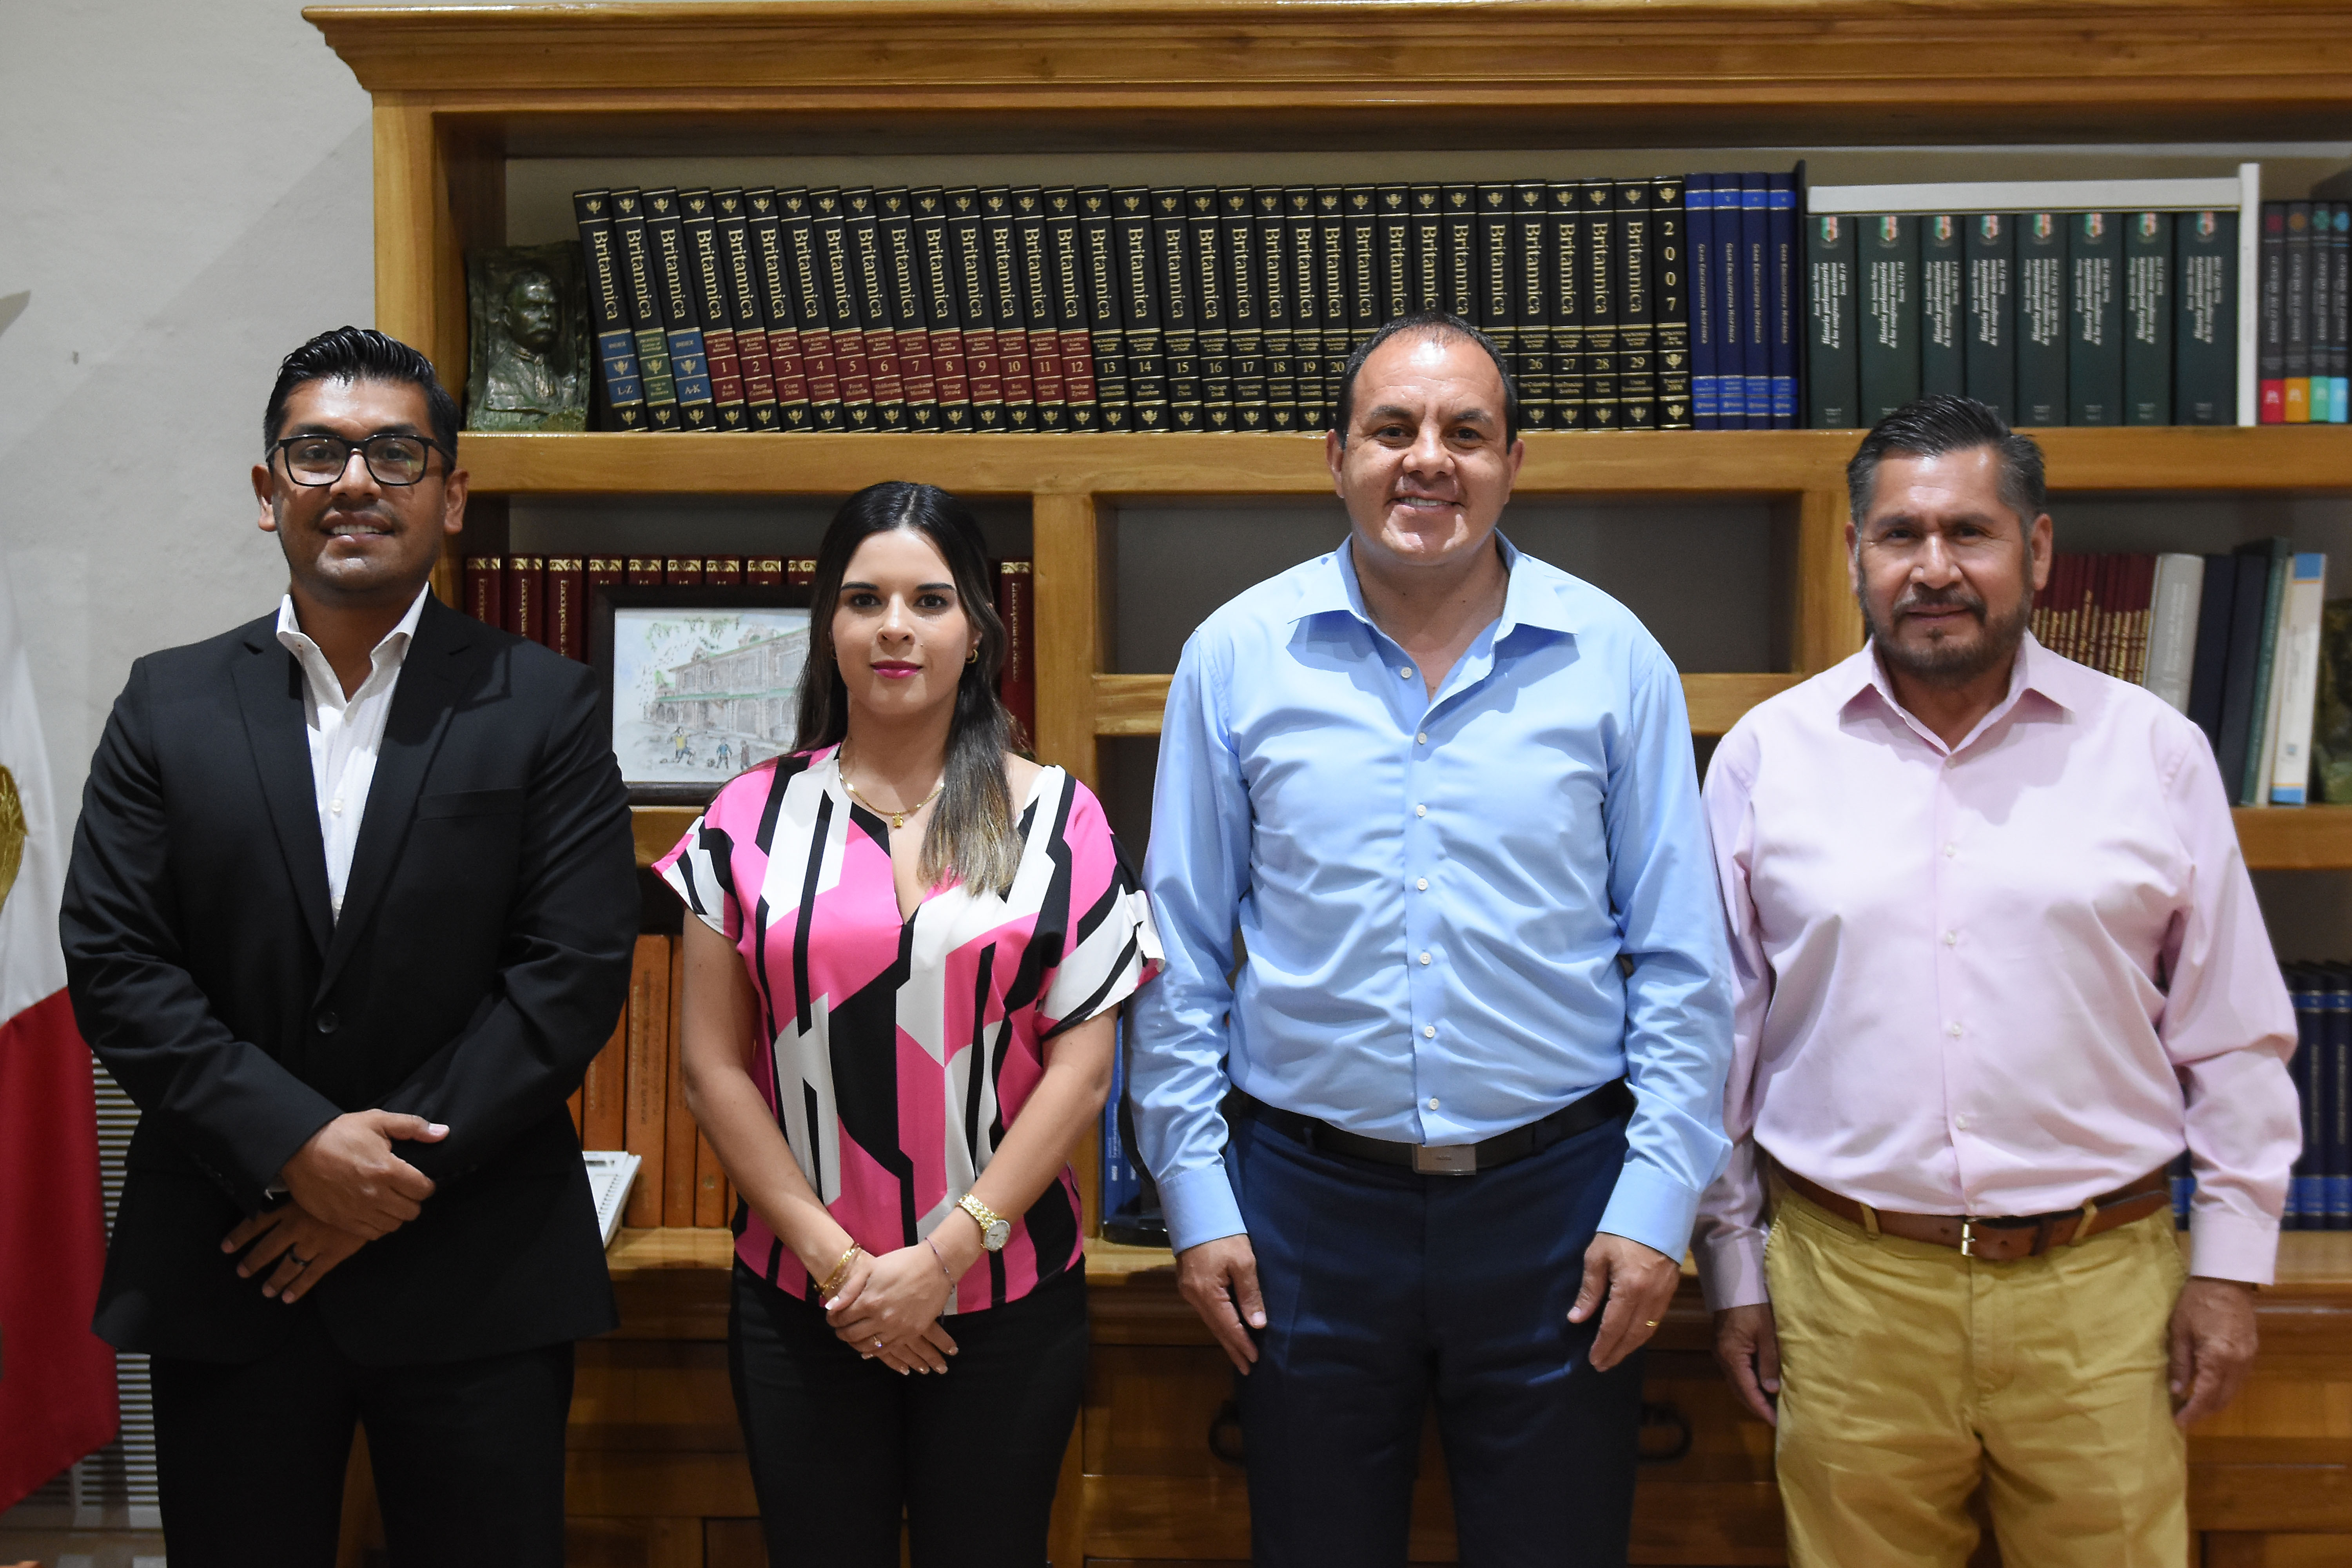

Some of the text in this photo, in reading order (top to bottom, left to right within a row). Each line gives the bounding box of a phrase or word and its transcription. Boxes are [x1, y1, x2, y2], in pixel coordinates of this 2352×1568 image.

[593, 231, 618, 319] Britannica
[626, 229, 652, 318] Britannica
[661, 229, 685, 318] Britannica
[697, 229, 722, 319] Britannica
[728, 229, 753, 318] Britannica
[761, 228, 786, 318] Britannica
[793, 228, 818, 318] Britannica
[826, 228, 851, 318] Britannica
[858, 228, 883, 318] Britannica
[892, 228, 915, 318] Britannica
[926, 228, 949, 318] Britannica
[961, 228, 983, 318] Britannica
[993, 228, 1015, 318] Britannica
[1024, 228, 1046, 318] Britannica
[1057, 228, 1079, 318] Britannica
[1091, 229, 1111, 319] Britannica
[1128, 227, 1149, 318] Britannica
[1166, 229, 1185, 318] Britannica
[1199, 229, 1219, 319] Britannica
[1232, 228, 1252, 318] Britannica
[1265, 228, 1283, 318] Britannica
[1296, 227, 1315, 318] Britannica
[1325, 227, 1343, 318] Britannica
[1356, 227, 1374, 317] Britannica
[1389, 226, 1407, 316] Britannica
[1421, 226, 1439, 310] Britannic
[1454, 225, 1471, 315] Britannica
[1490, 225, 1507, 315] Britannica
[1525, 224, 1542, 315] Britannica
[1559, 223, 1576, 314] Britannica
[1592, 223, 1609, 314] Britannica
[1628, 222, 1644, 312] Britannica
[722, 362, 727, 373] 1
[752, 361, 760, 372] 2
[784, 361, 791, 372] 3
[816, 360, 824, 371] 4
[849, 360, 857, 372] 5
[880, 360, 889, 372] 6
[912, 360, 919, 371] 7
[945, 361, 953, 371] 8
[978, 360, 986, 372] 9
[1008, 361, 1021, 372] 10
[1040, 361, 1051, 372] 11
[1071, 361, 1084, 372] 12
[1103, 361, 1116, 373] 13
[1139, 361, 1152, 372] 14
[1177, 361, 1189, 373] 15
[1209, 361, 1222, 373] 16
[1242, 361, 1254, 372] 17
[1274, 361, 1286, 372] 18
[1303, 361, 1316, 372] 19
[1330, 361, 1345, 372] 20
[1529, 358, 1543, 370] 26
[1562, 358, 1576, 370] 27
[1596, 358, 1609, 370] 28
[1630, 356, 1645, 368] 29
